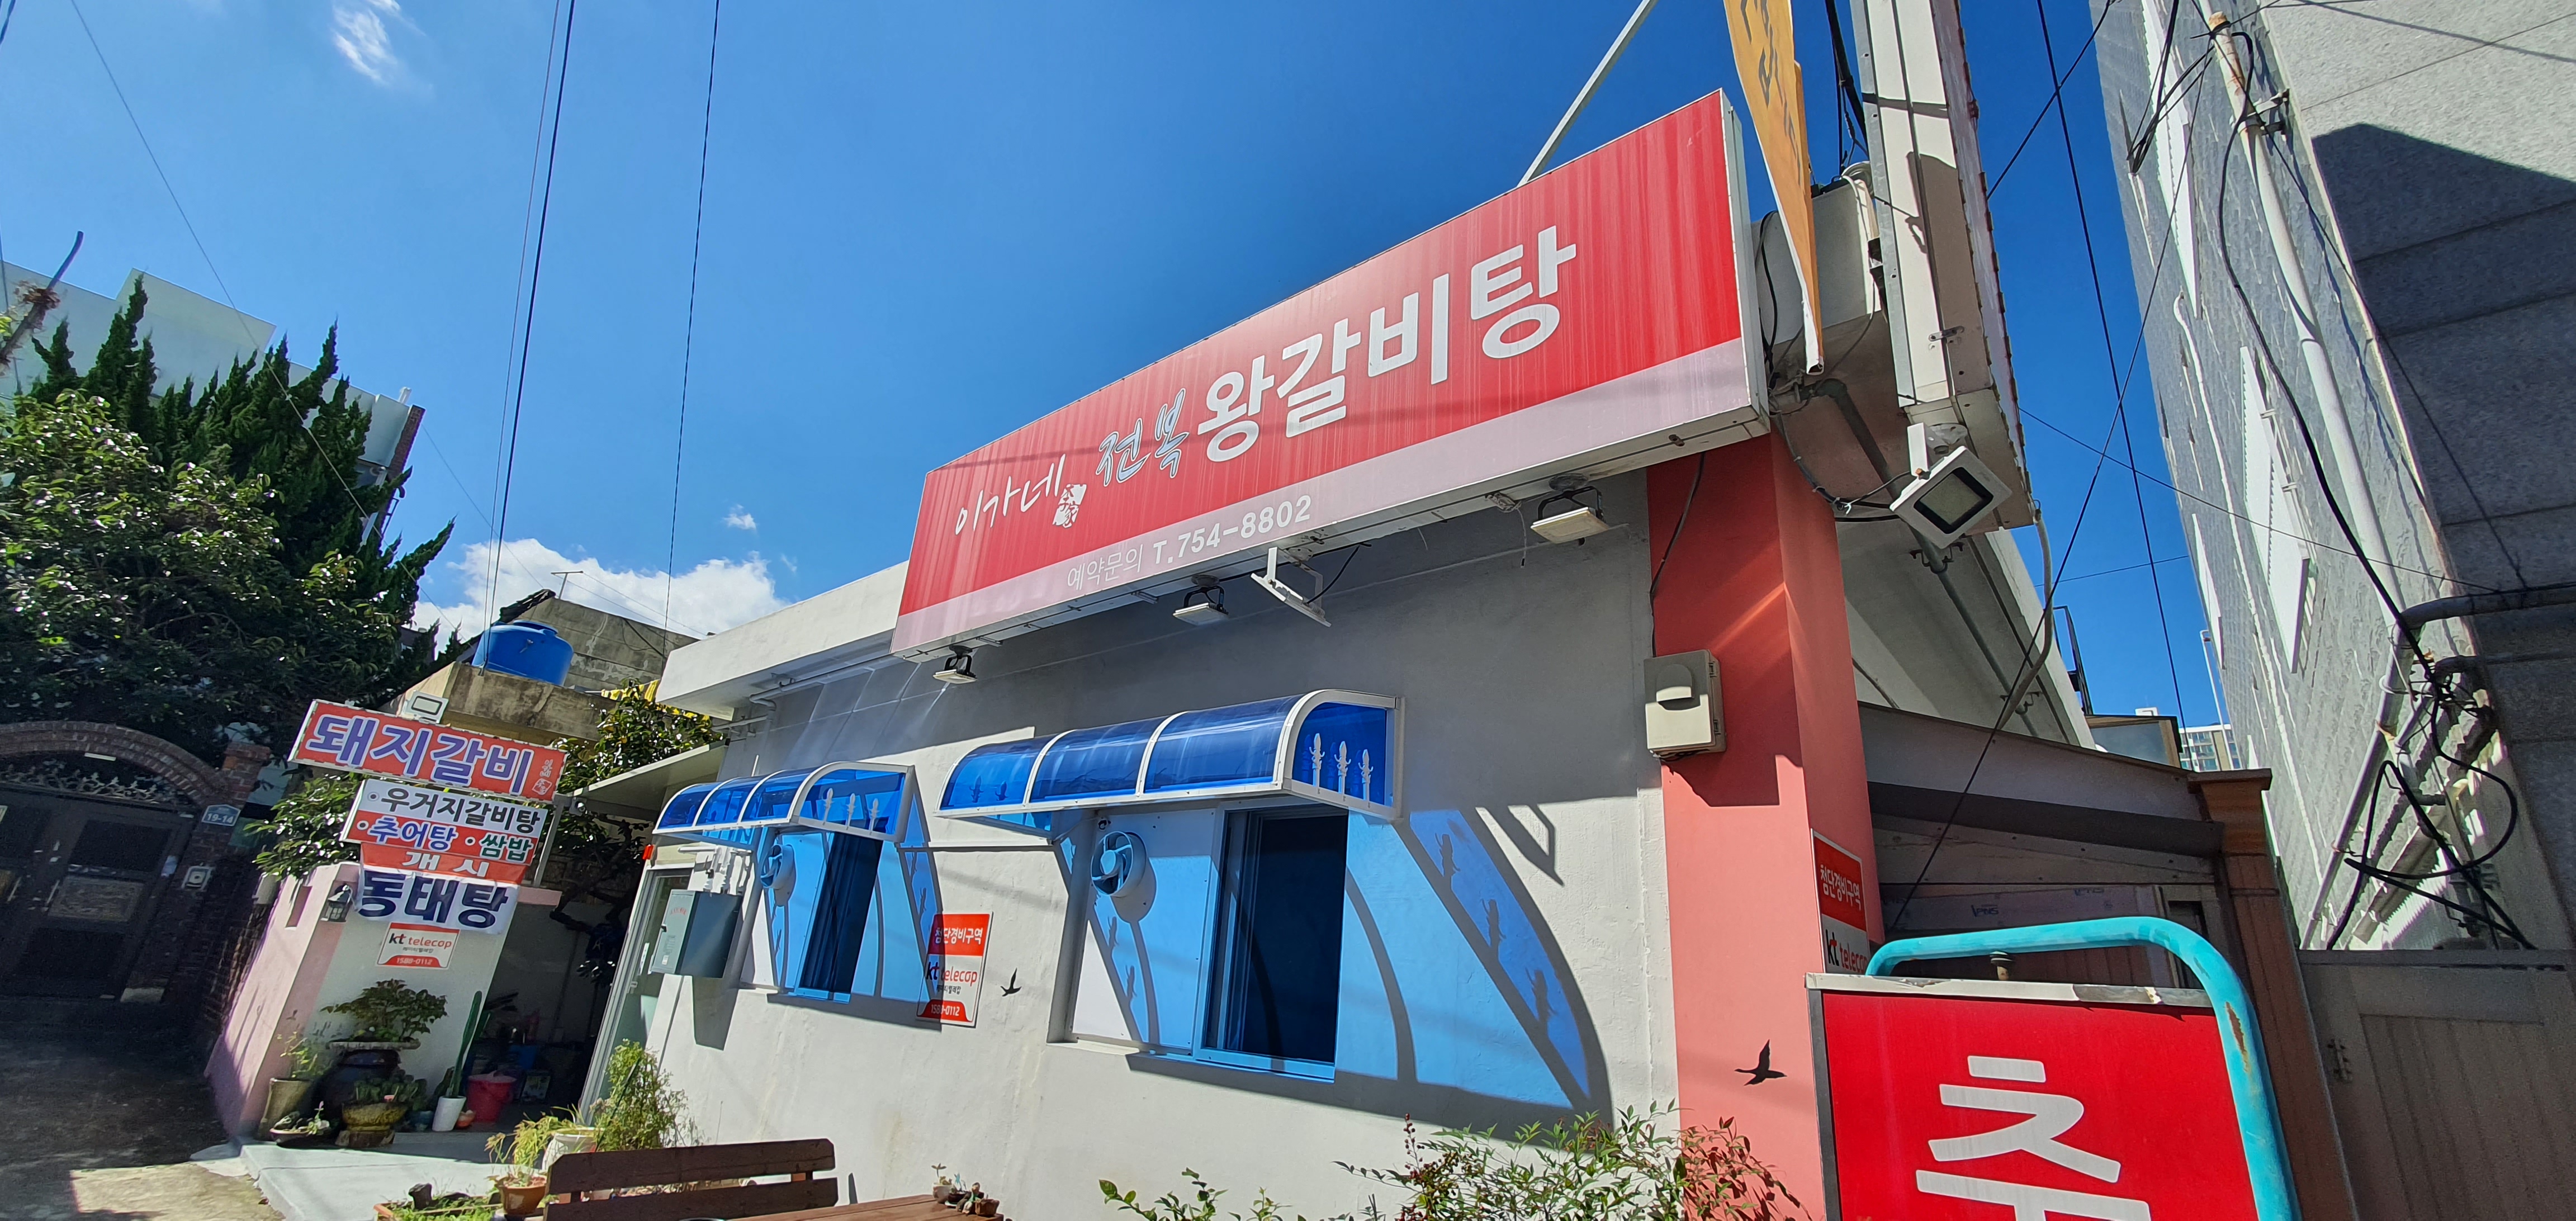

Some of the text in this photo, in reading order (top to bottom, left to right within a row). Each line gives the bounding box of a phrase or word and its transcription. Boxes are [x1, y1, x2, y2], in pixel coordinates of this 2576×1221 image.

[1095, 225, 1577, 487] 전복 왕갈비탕
[955, 453, 1066, 536] 이가네
[1067, 543, 1143, 591] 예약문의
[306, 714, 534, 794] 돼지갈비
[207, 813, 234, 824] 19-14
[381, 788, 540, 834] 우거지갈비탕
[368, 816, 533, 862] 추어탕 쌈밥
[358, 870, 509, 929] 동태탕
[1820, 864, 1862, 911] 첨단경비구역
[389, 933, 452, 949] kt telecop
[935, 927, 983, 945] 첨단경비구역
[1825, 929, 1839, 966] kt
[926, 962, 977, 987] kt telecop
